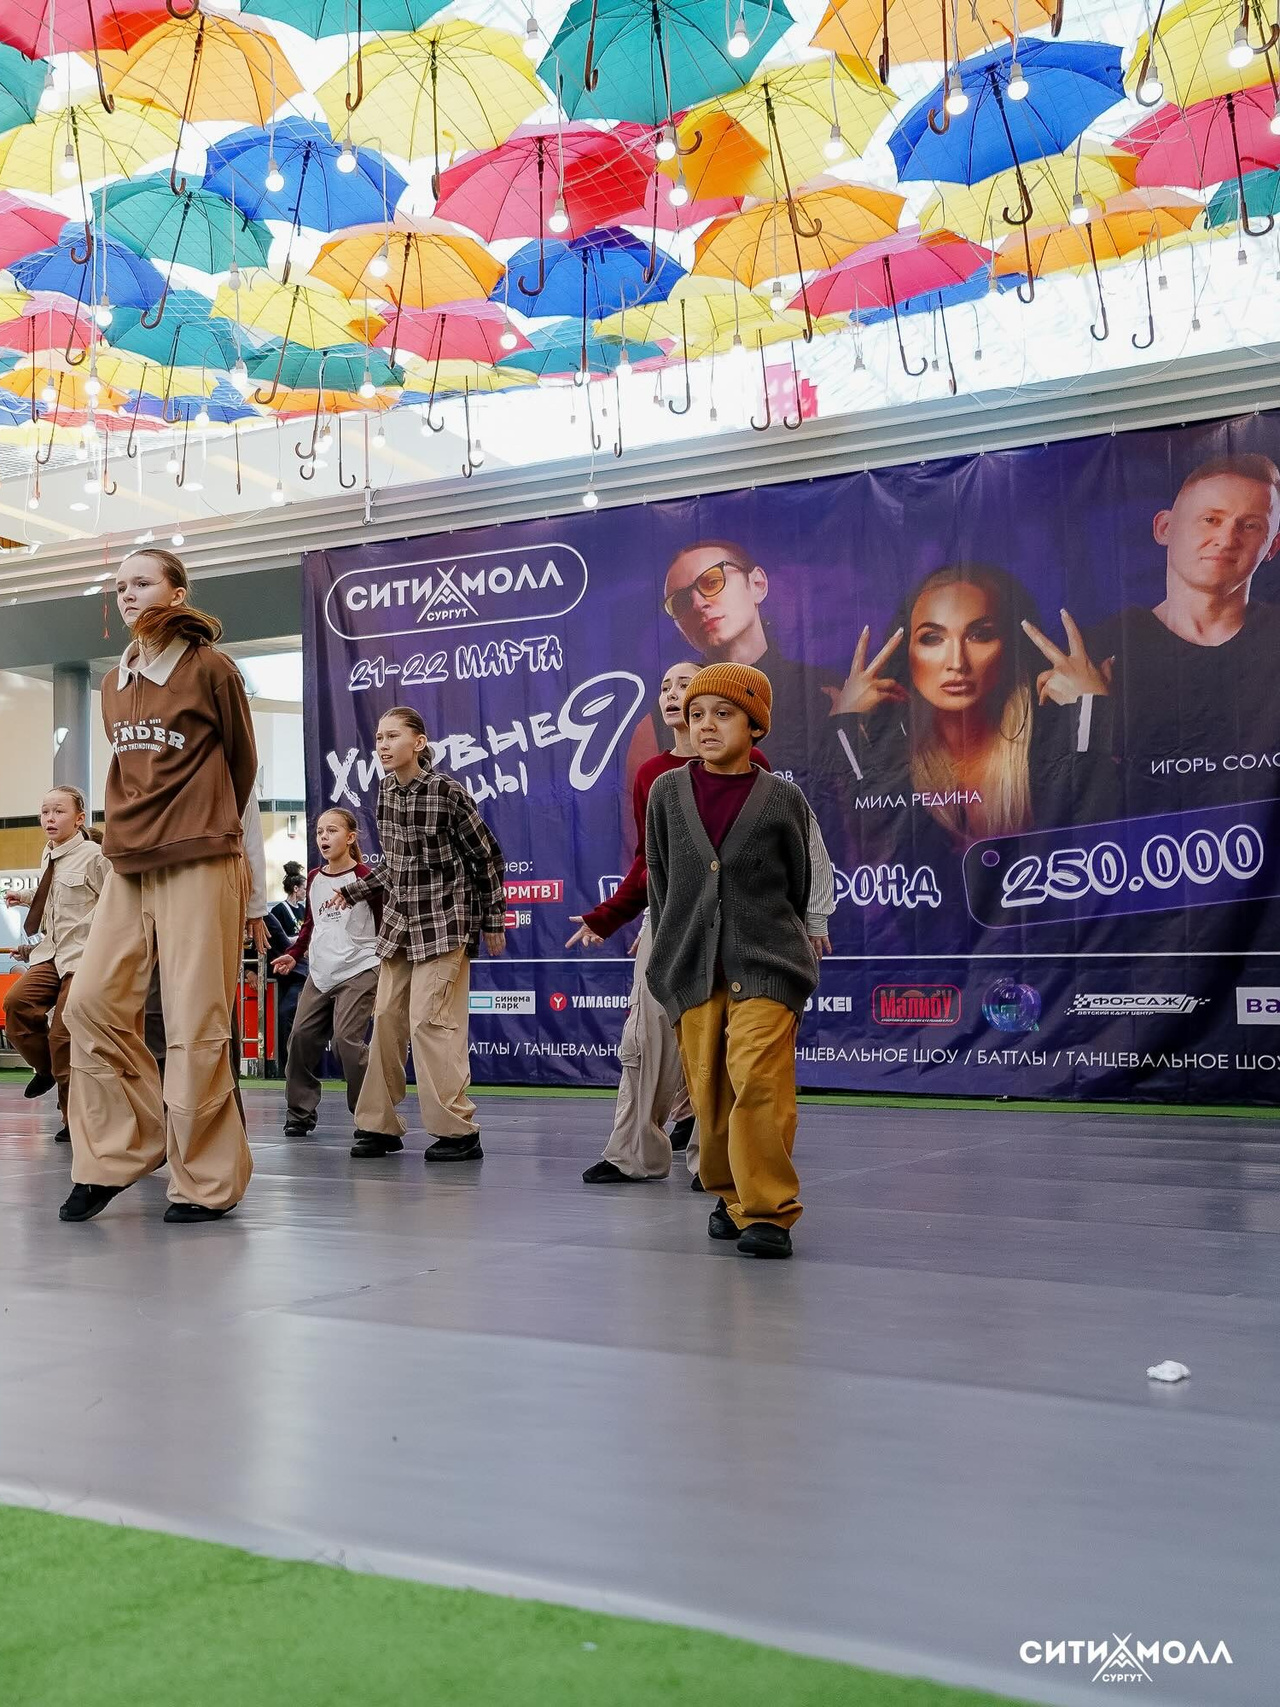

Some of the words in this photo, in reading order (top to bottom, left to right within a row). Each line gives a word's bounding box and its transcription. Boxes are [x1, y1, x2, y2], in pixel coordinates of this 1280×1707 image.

[426, 607, 468, 623] СУРГУТ
[348, 651, 449, 692] 21-22
[456, 635, 564, 681] МАРТА
[1151, 758, 1217, 775] ИГОРЬ
[855, 795, 907, 810] МИЛА
[912, 790, 982, 807] РЕДИНА
[1001, 824, 1264, 908] 250.000
[495, 996, 531, 1004] синема
[495, 1003, 519, 1012] парк
[1092, 997, 1180, 1006] ФОРСАЖ
[468, 1042, 510, 1055] АТТЛЫ
[524, 1043, 622, 1057] ТАНЦЕВАЛЬН
[794, 1047, 908, 1063] НЦЕВАЛЬНОЕ
[913, 1048, 959, 1064] ШОУ
[977, 1050, 1046, 1066] БАТТЛЫ
[1066, 1051, 1229, 1069] ТАНЦЕВАЛЬНОЕ
